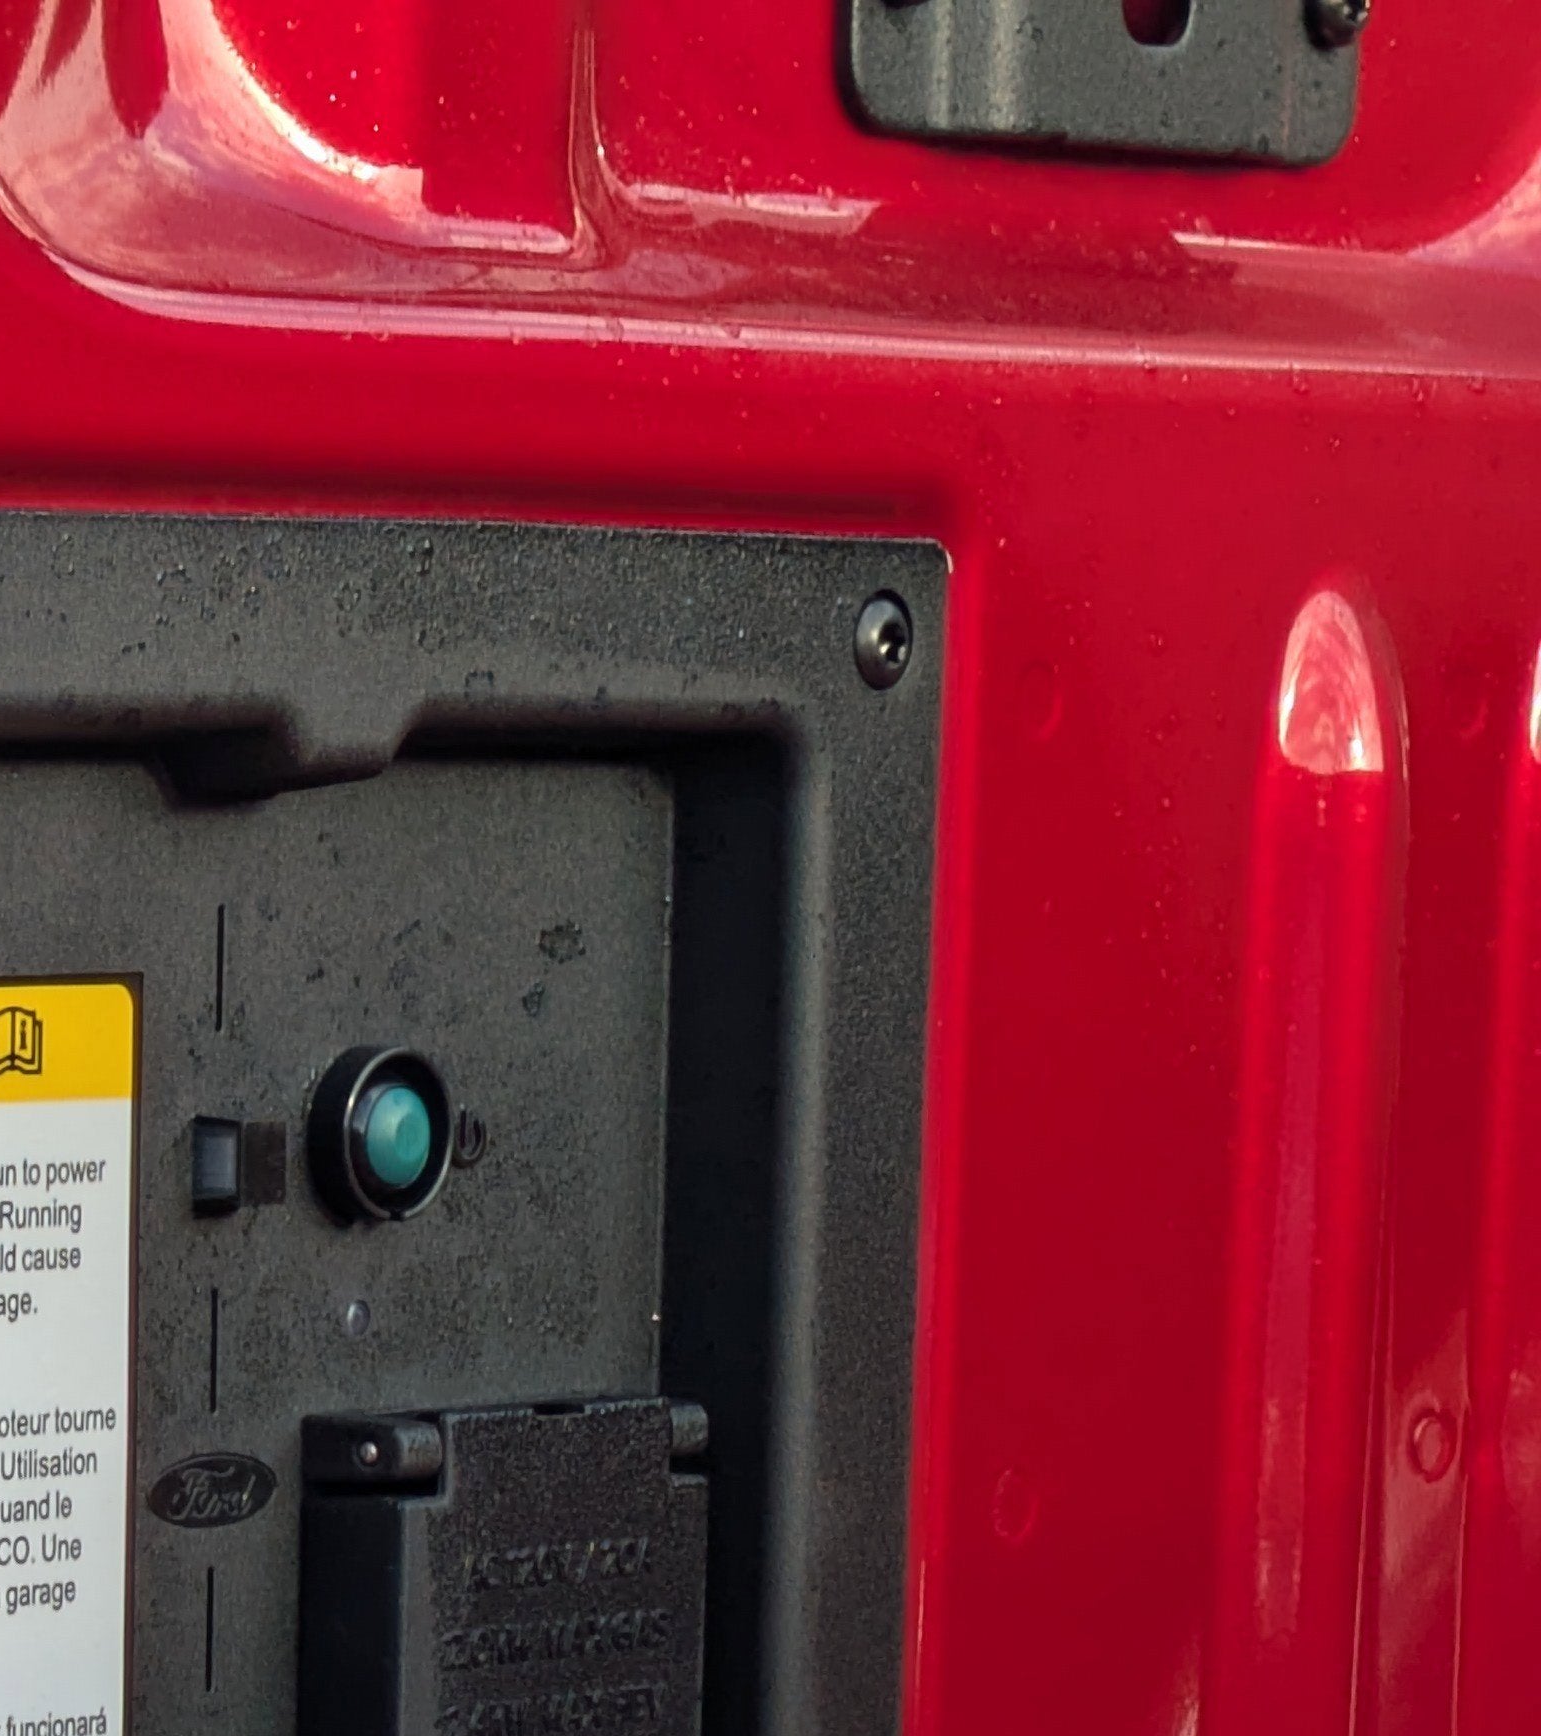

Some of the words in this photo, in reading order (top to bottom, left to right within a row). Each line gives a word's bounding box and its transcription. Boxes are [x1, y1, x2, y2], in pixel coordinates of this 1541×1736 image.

[22, 1158, 41, 1186] to
[46, 1157, 105, 1191] power
[0, 1200, 83, 1235] Running
[22, 1246, 82, 1272] cause
[0, 1447, 98, 1481] Utilisation
[56, 1490, 72, 1519] le
[163, 1463, 260, 1521] Ford
[41, 1534, 82, 1563] Une
[7, 1580, 76, 1615] garage
